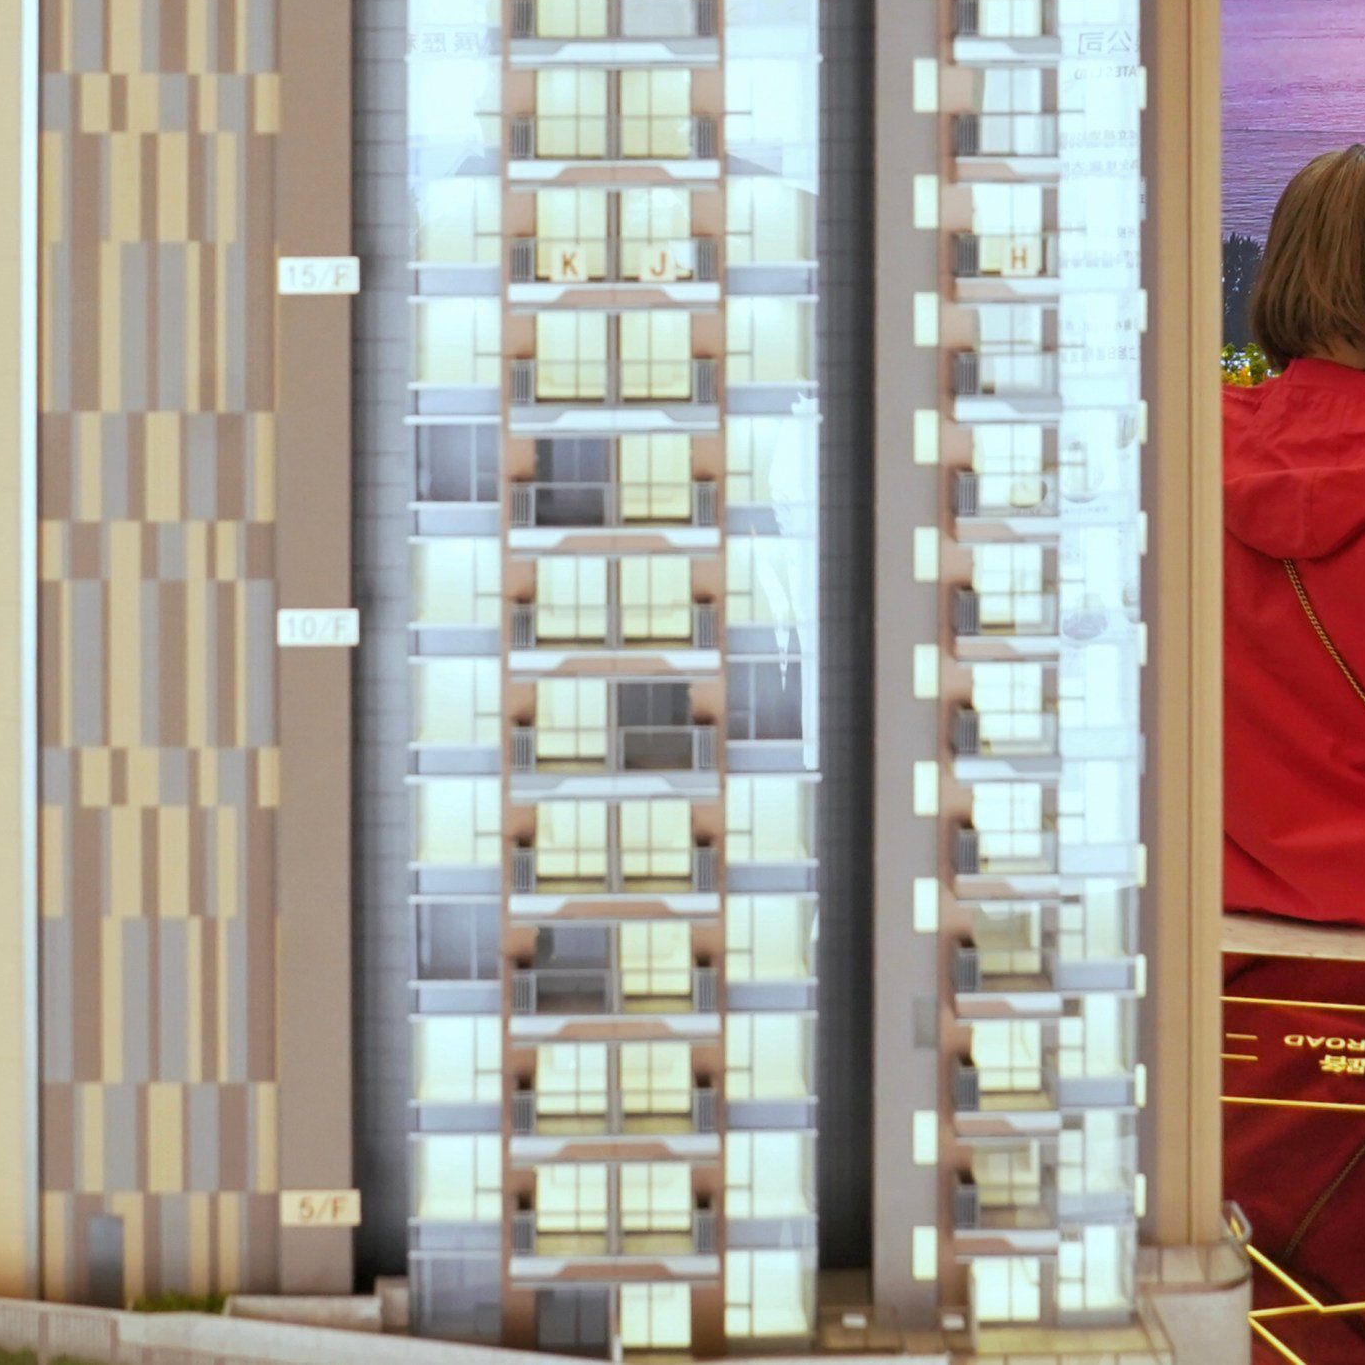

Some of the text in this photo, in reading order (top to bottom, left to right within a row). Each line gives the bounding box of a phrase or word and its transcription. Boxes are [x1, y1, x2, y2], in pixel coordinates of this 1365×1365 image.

[561, 250, 578, 276] K
[650, 251, 667, 277] J
[1010, 244, 1027, 269] H
[287, 262, 351, 288] 15/F
[286, 614, 350, 640] 10/F
[298, 1195, 348, 1222] 5/F
